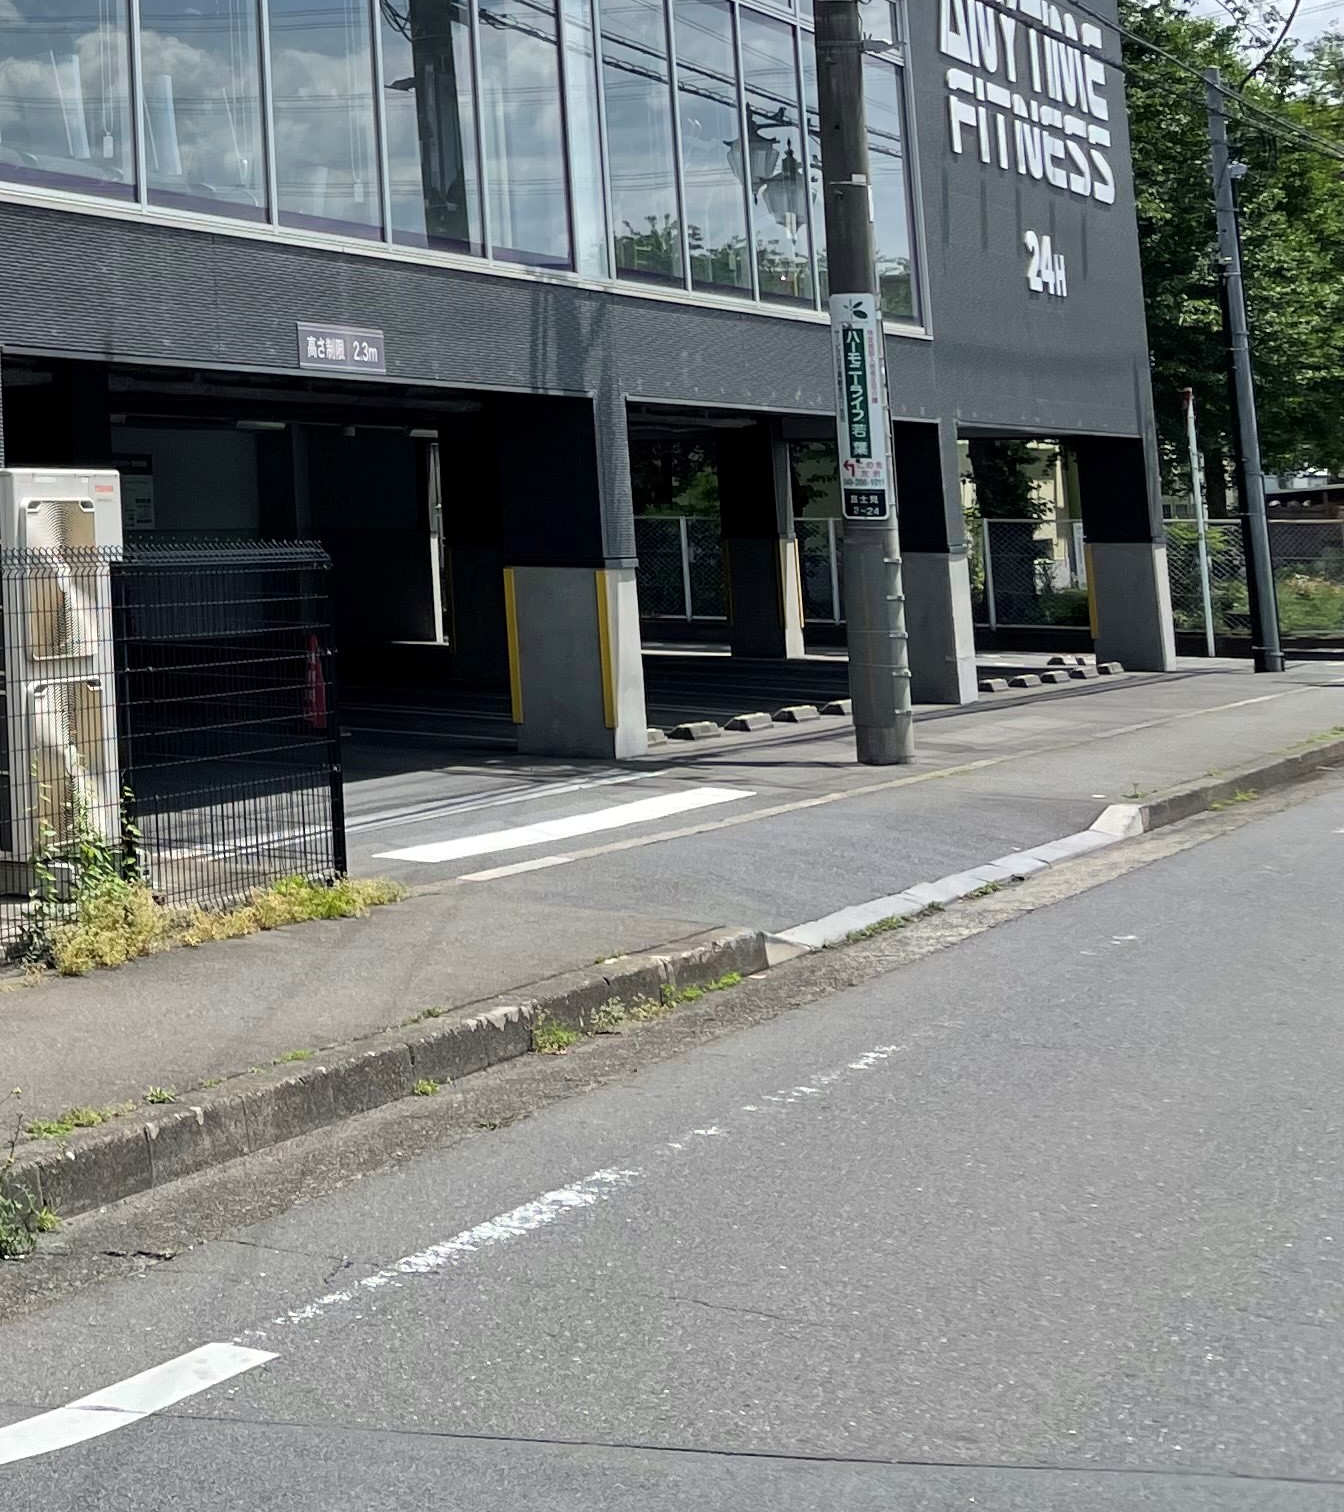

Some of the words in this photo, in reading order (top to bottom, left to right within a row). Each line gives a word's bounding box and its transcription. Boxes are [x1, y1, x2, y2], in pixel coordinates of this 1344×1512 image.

[946, 67, 1115, 204] FITNESS
[1024, 230, 1067, 297] 24H
[306, 335, 345, 360] 高さ制限
